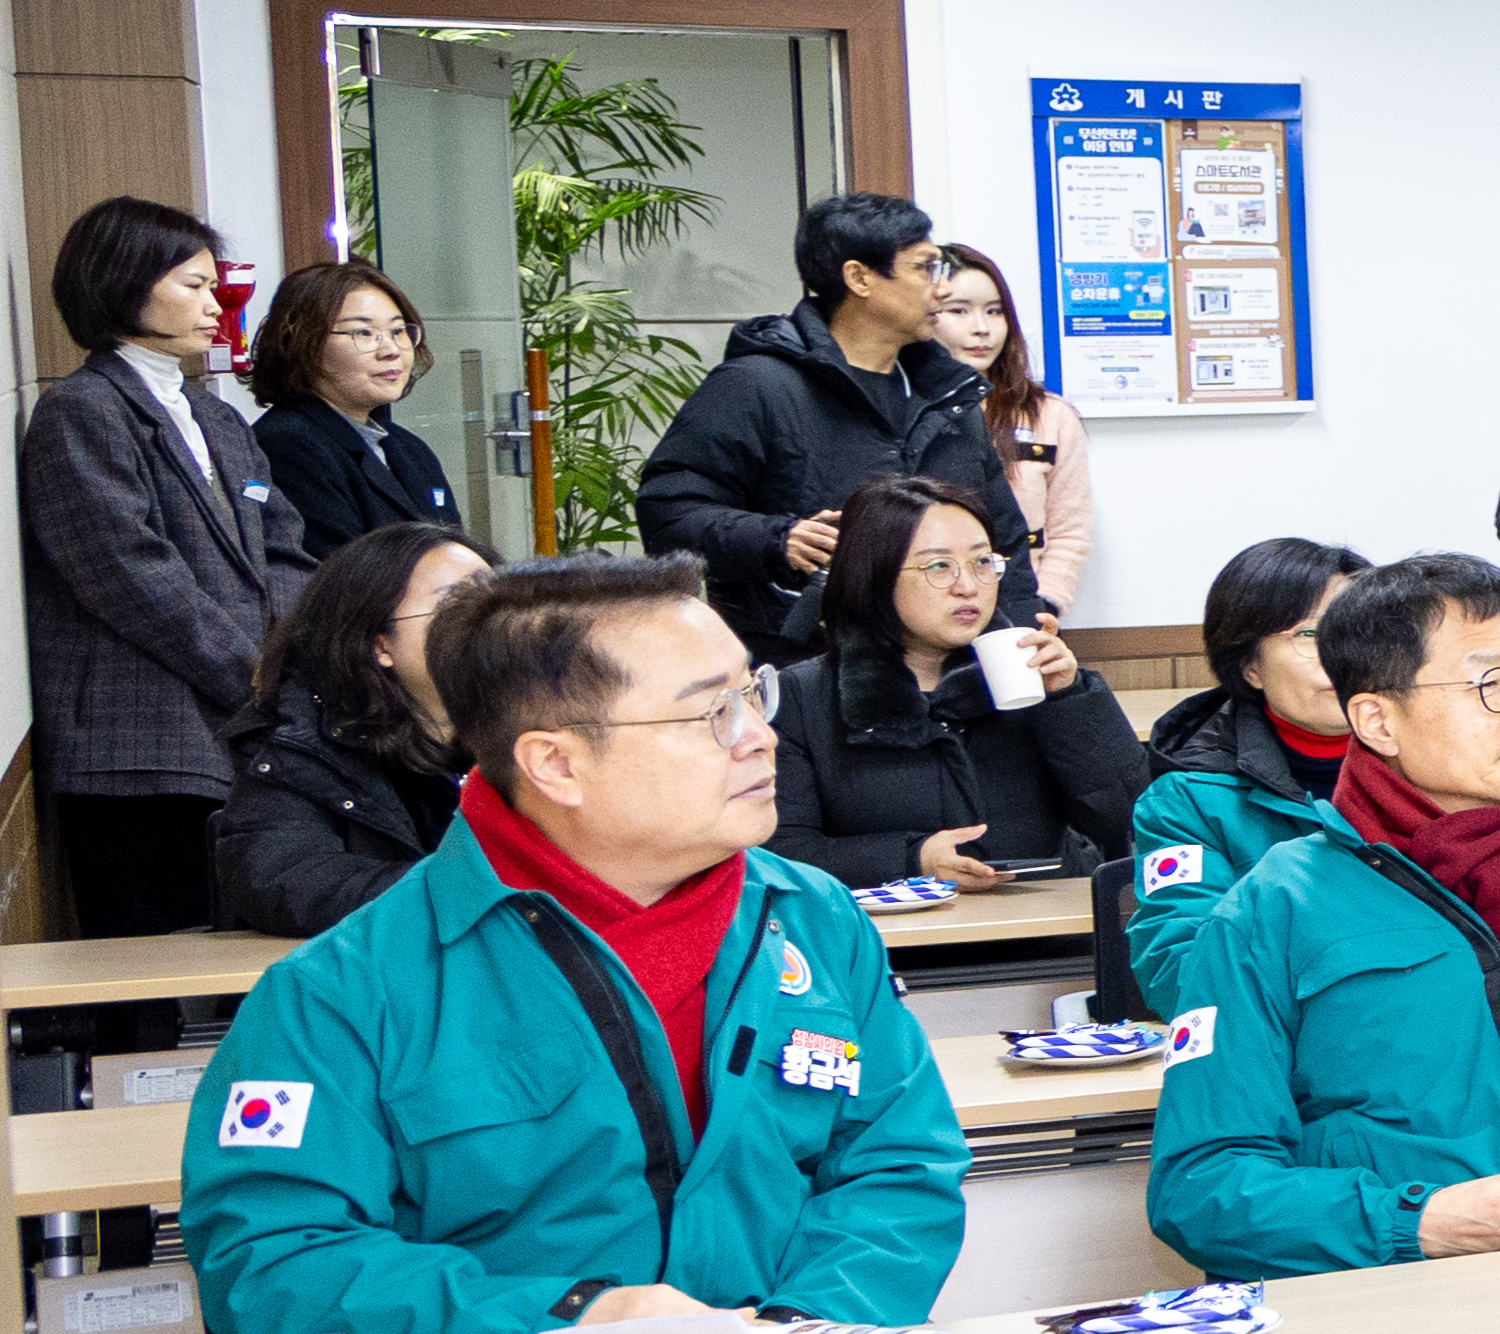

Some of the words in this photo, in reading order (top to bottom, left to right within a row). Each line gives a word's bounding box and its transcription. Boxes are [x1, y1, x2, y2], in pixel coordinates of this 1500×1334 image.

[1078, 127, 1138, 141] 무선인터넷
[1082, 140, 1107, 153] 이용
[1108, 141, 1134, 153] 안내
[1195, 165, 1262, 178] 스마트도서관
[782, 1045, 861, 1097] 황금석
